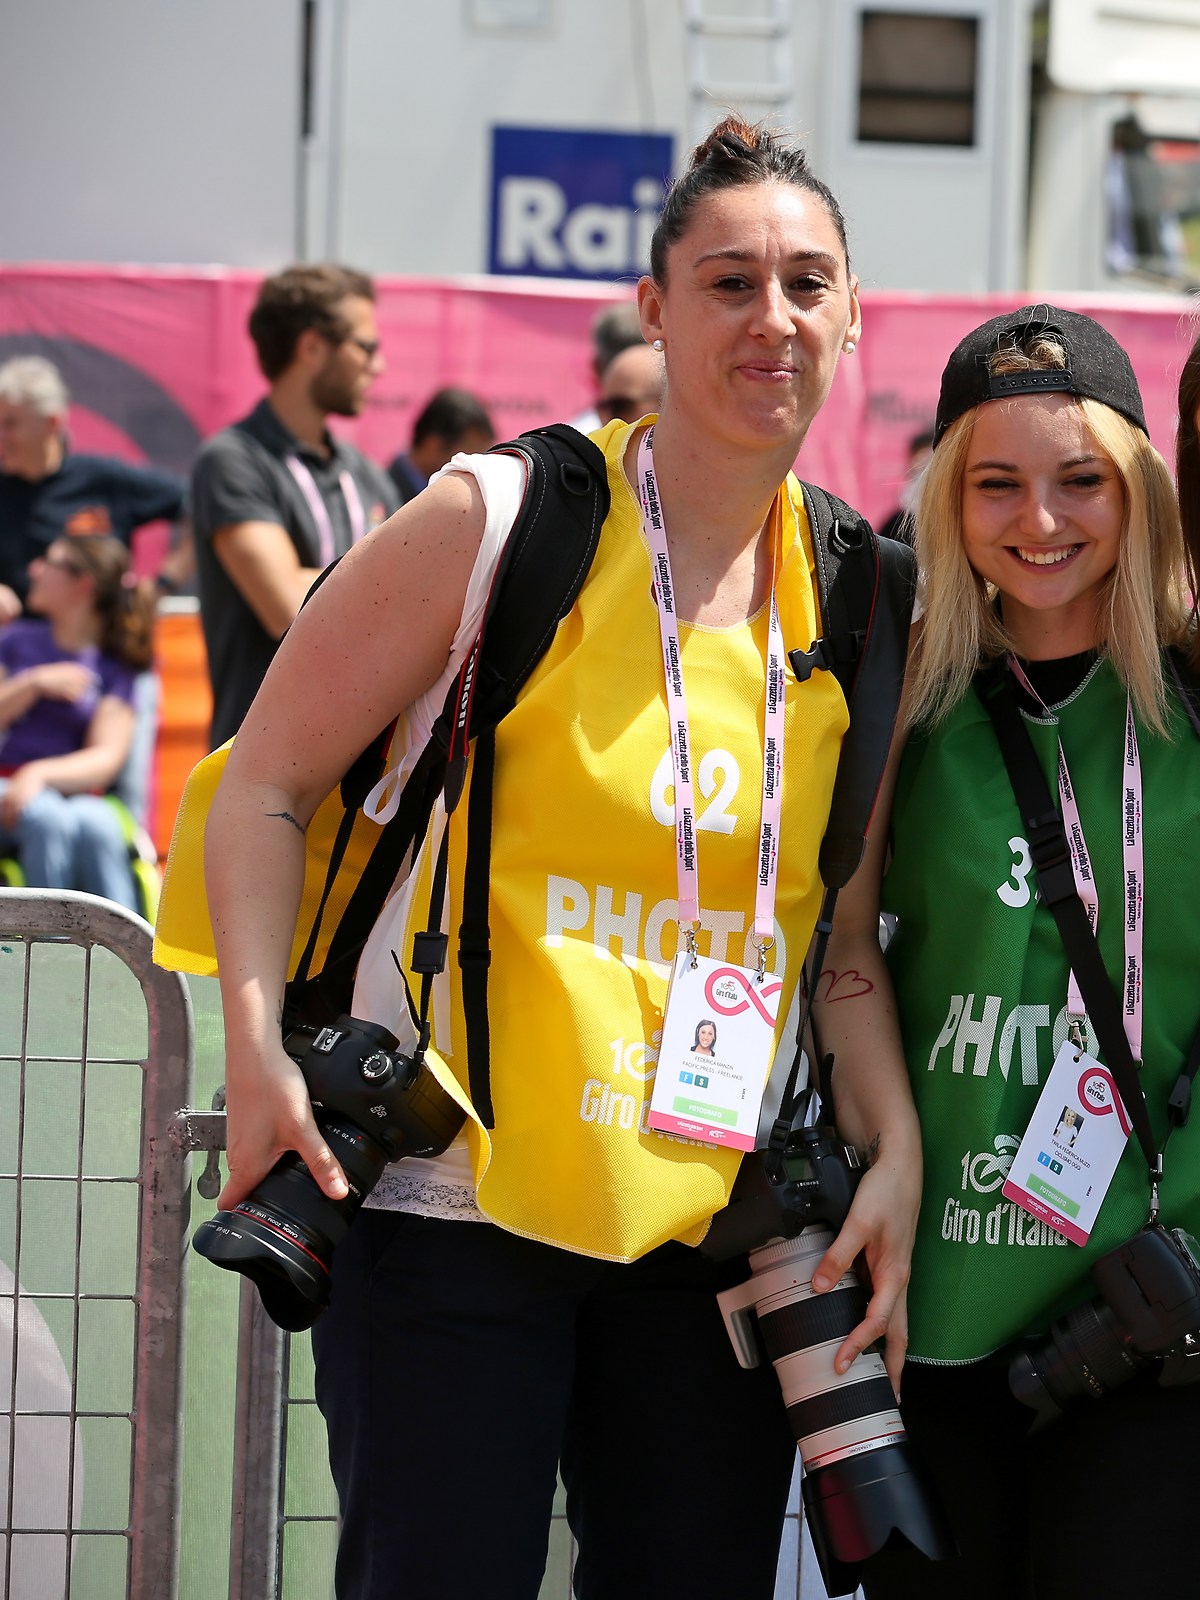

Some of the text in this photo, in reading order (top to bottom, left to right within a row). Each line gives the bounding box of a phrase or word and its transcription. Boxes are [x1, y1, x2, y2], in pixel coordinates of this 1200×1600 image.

[498, 174, 662, 274] Rai
[645, 470, 653, 478] La
[646, 476, 657, 502] Gazzetta
[650, 500, 659, 513] dello
[651, 512, 662, 530] Sport
[658, 560, 669, 584] Gazzetta
[662, 584, 671, 596] dello
[663, 596, 674, 613] Sport
[669, 644, 679, 667] Gazzetta
[769, 654, 778, 669] Sport
[672, 667, 680, 681] dello
[769, 669, 777, 682] dello
[672, 682, 682, 697] Sport
[768, 682, 777, 706] Gazzetta
[678, 728, 687, 752] Gazzetta
[766, 737, 776, 752] Sport
[766, 753, 774, 767] dello
[680, 768, 689, 783] Sport
[765, 767, 774, 791] Gazzetta
[1125, 788, 1136, 803] Sport
[1125, 802, 1134, 816] dello
[684, 815, 692, 840] Gazzetta
[762, 823, 772, 839] Sport
[1125, 816, 1134, 839] Gazzetta
[685, 840, 694, 855] dello
[761, 839, 771, 853] dello
[683, 855, 694, 871] Sport
[759, 853, 770, 878] Gazzetta
[996, 836, 1040, 908] 3
[1127, 870, 1137, 886] Sport
[1127, 886, 1136, 899] dello
[1127, 900, 1136, 924] Gazzetta
[1127, 955, 1137, 971] Sport
[1127, 971, 1135, 984] dello
[1126, 984, 1135, 1008] Gazzetta
[370, 1105, 385, 1114] EOS
[580, 1078, 636, 1129] Giro
[268, 1217, 281, 1227] ZOOM
[942, 1198, 980, 1244] Giro
[282, 1226, 298, 1239] CANON
[848, 1443, 873, 1454] ULTRASONIC
